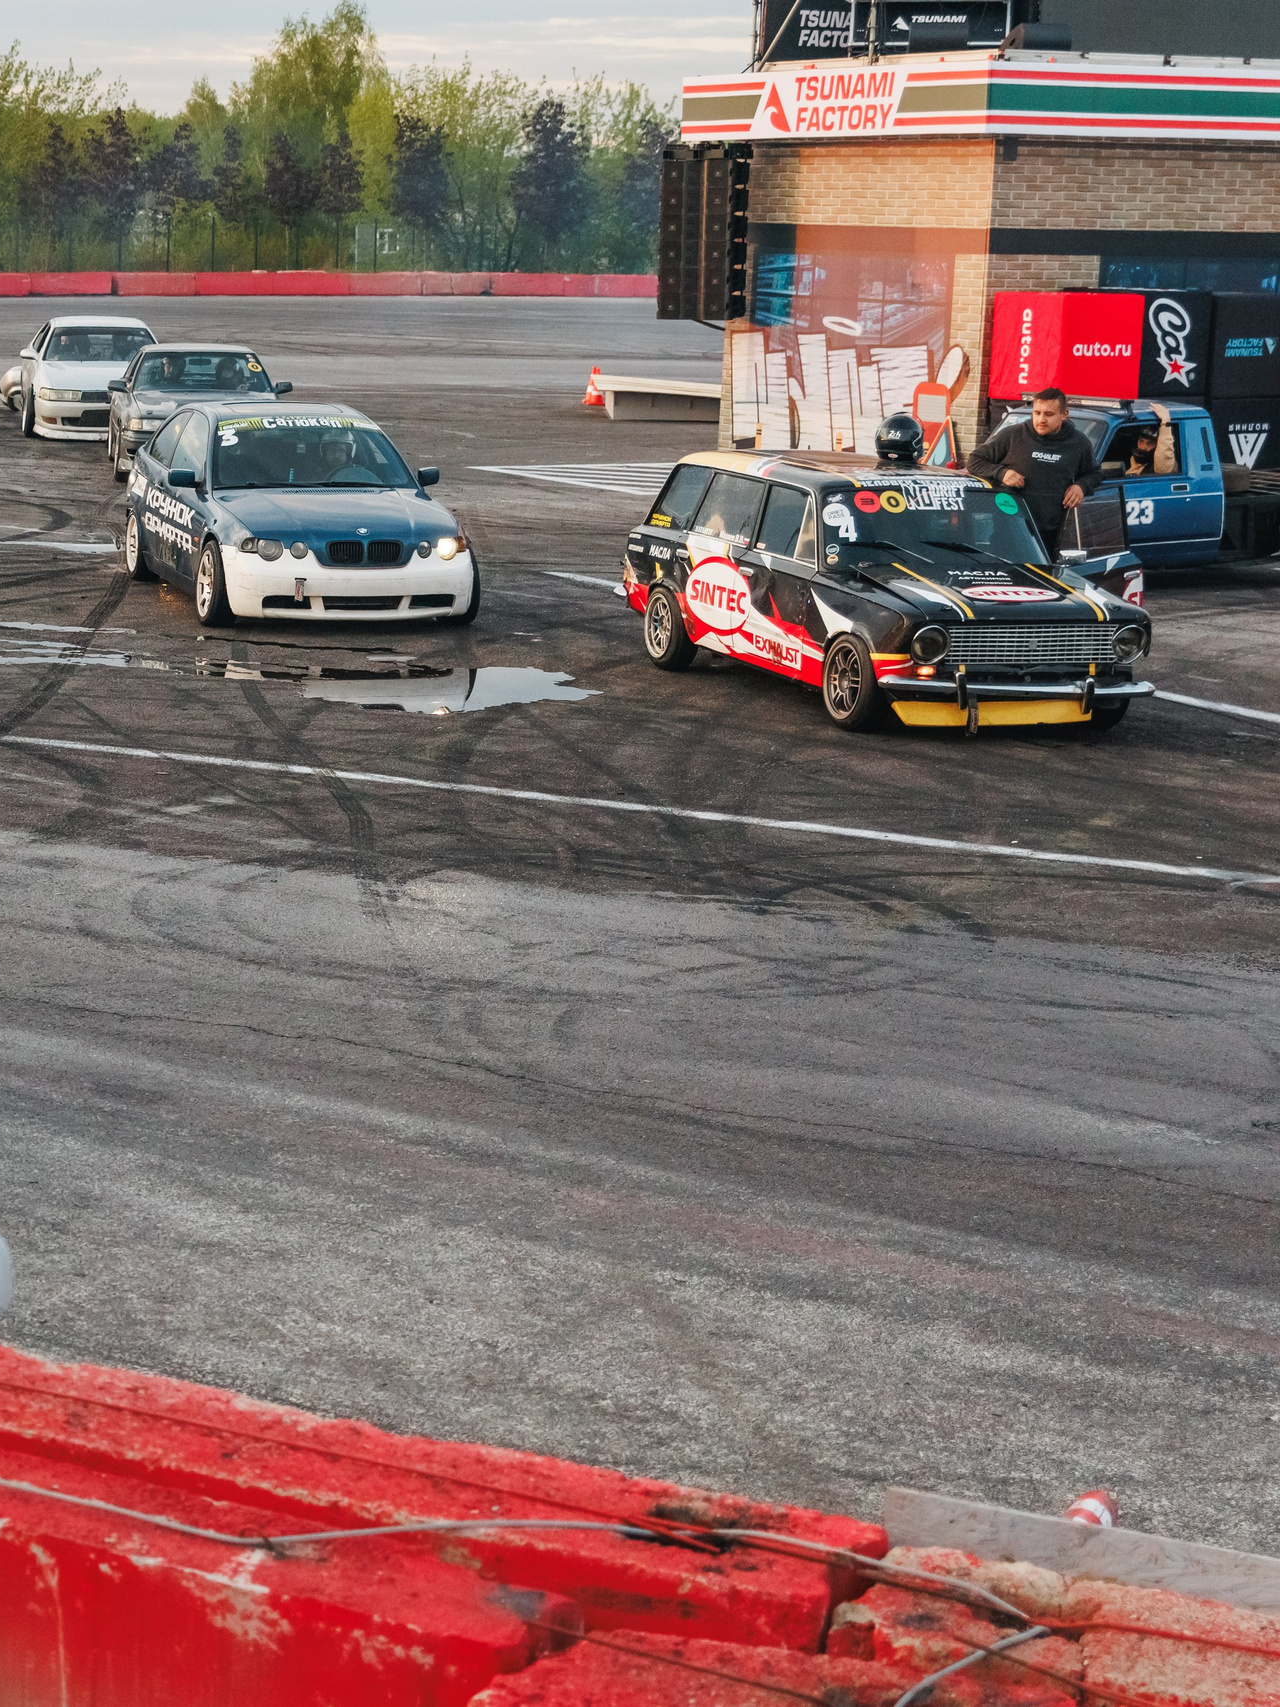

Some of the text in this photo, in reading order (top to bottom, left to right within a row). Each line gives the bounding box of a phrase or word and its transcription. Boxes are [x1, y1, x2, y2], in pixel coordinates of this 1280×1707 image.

[911, 15, 967, 24] TSUNAMI
[795, 72, 895, 101] TSUNAMI
[795, 103, 894, 132] FACTORY
[1018, 308, 1033, 385] auto.ru
[1072, 342, 1132, 357] auto.ru
[1225, 338, 1264, 348] FACTORY
[1224, 347, 1263, 357] TSUNAMI
[1228, 423, 1269, 431] МОЛНИЯ
[218, 428, 239, 446] 3
[1031, 451, 1062, 461] EXHAUST
[932, 486, 966, 498] DRIFT
[145, 487, 196, 530] КРУЖОК
[935, 498, 965, 511] FEST
[1126, 499, 1155, 526] 23
[838, 516, 858, 542] 4
[648, 544, 671, 560] МАСЛА
[690, 579, 747, 615] SINTEC
[754, 634, 800, 665] EXHAUST
